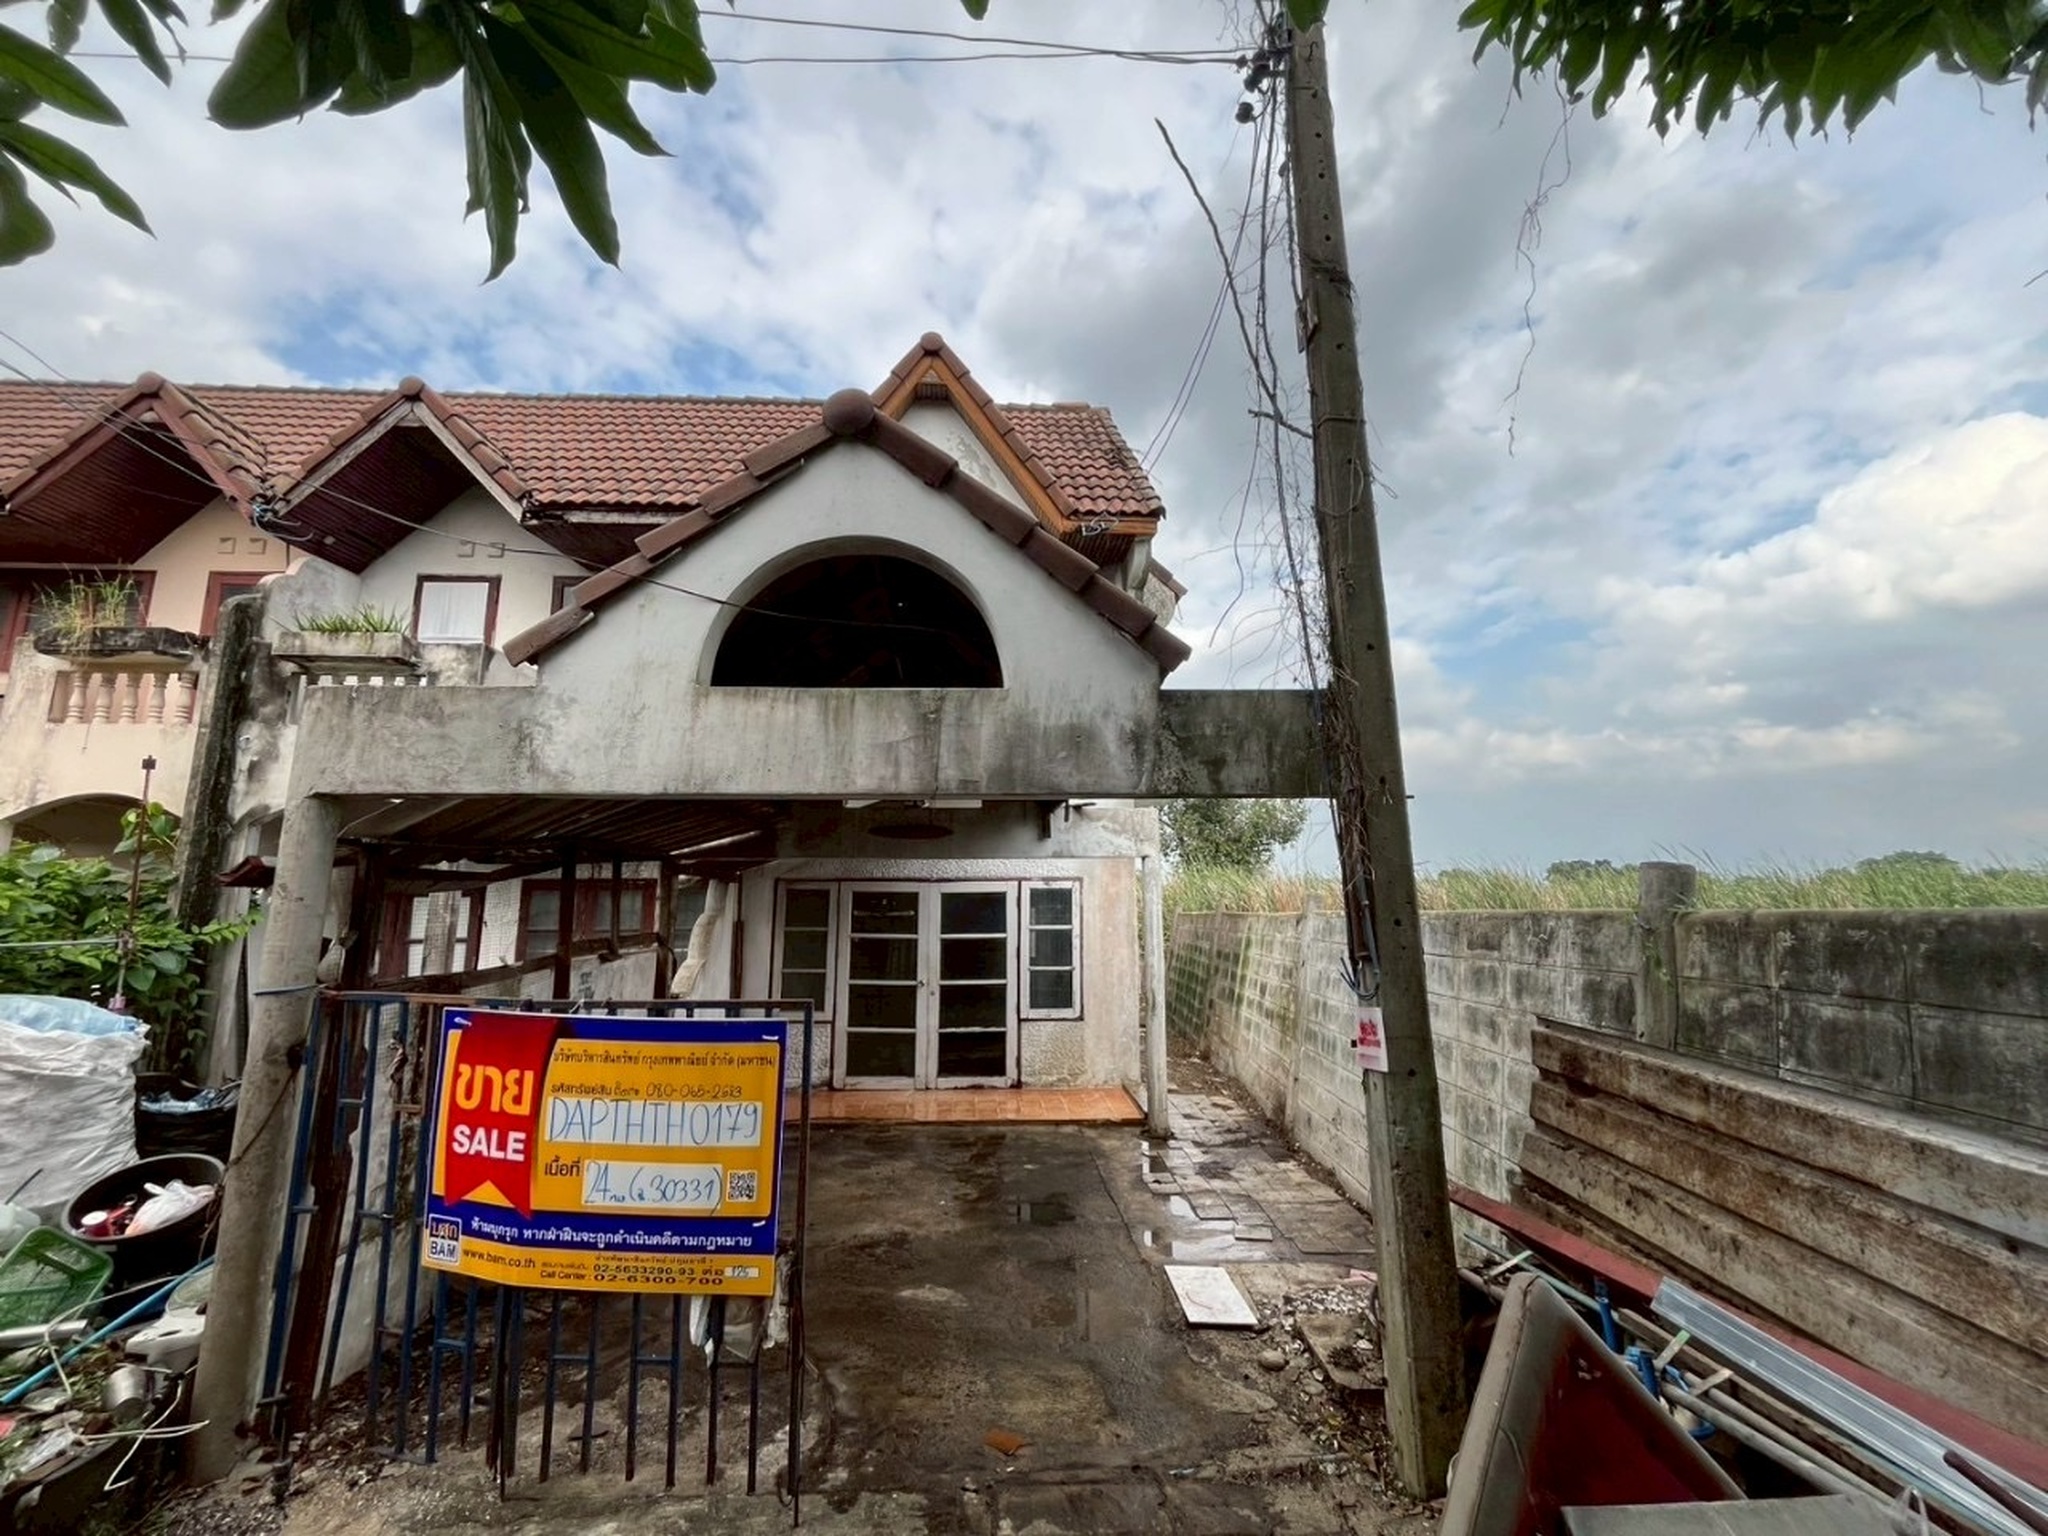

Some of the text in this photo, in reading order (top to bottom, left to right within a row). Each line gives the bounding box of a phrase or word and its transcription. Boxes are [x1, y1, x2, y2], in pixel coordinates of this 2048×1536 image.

[455, 1063, 534, 1116] ขาย
[452, 1124, 526, 1162] SALE
[545, 1155, 580, 1177] เนื้อที่
[470, 1216, 518, 1242] ห้ามบุกรุก
[430, 1240, 457, 1259] BAM
[463, 1248, 536, 1269] www.bam.co.th
[594, 1273, 723, 1286] 02-6300-700
